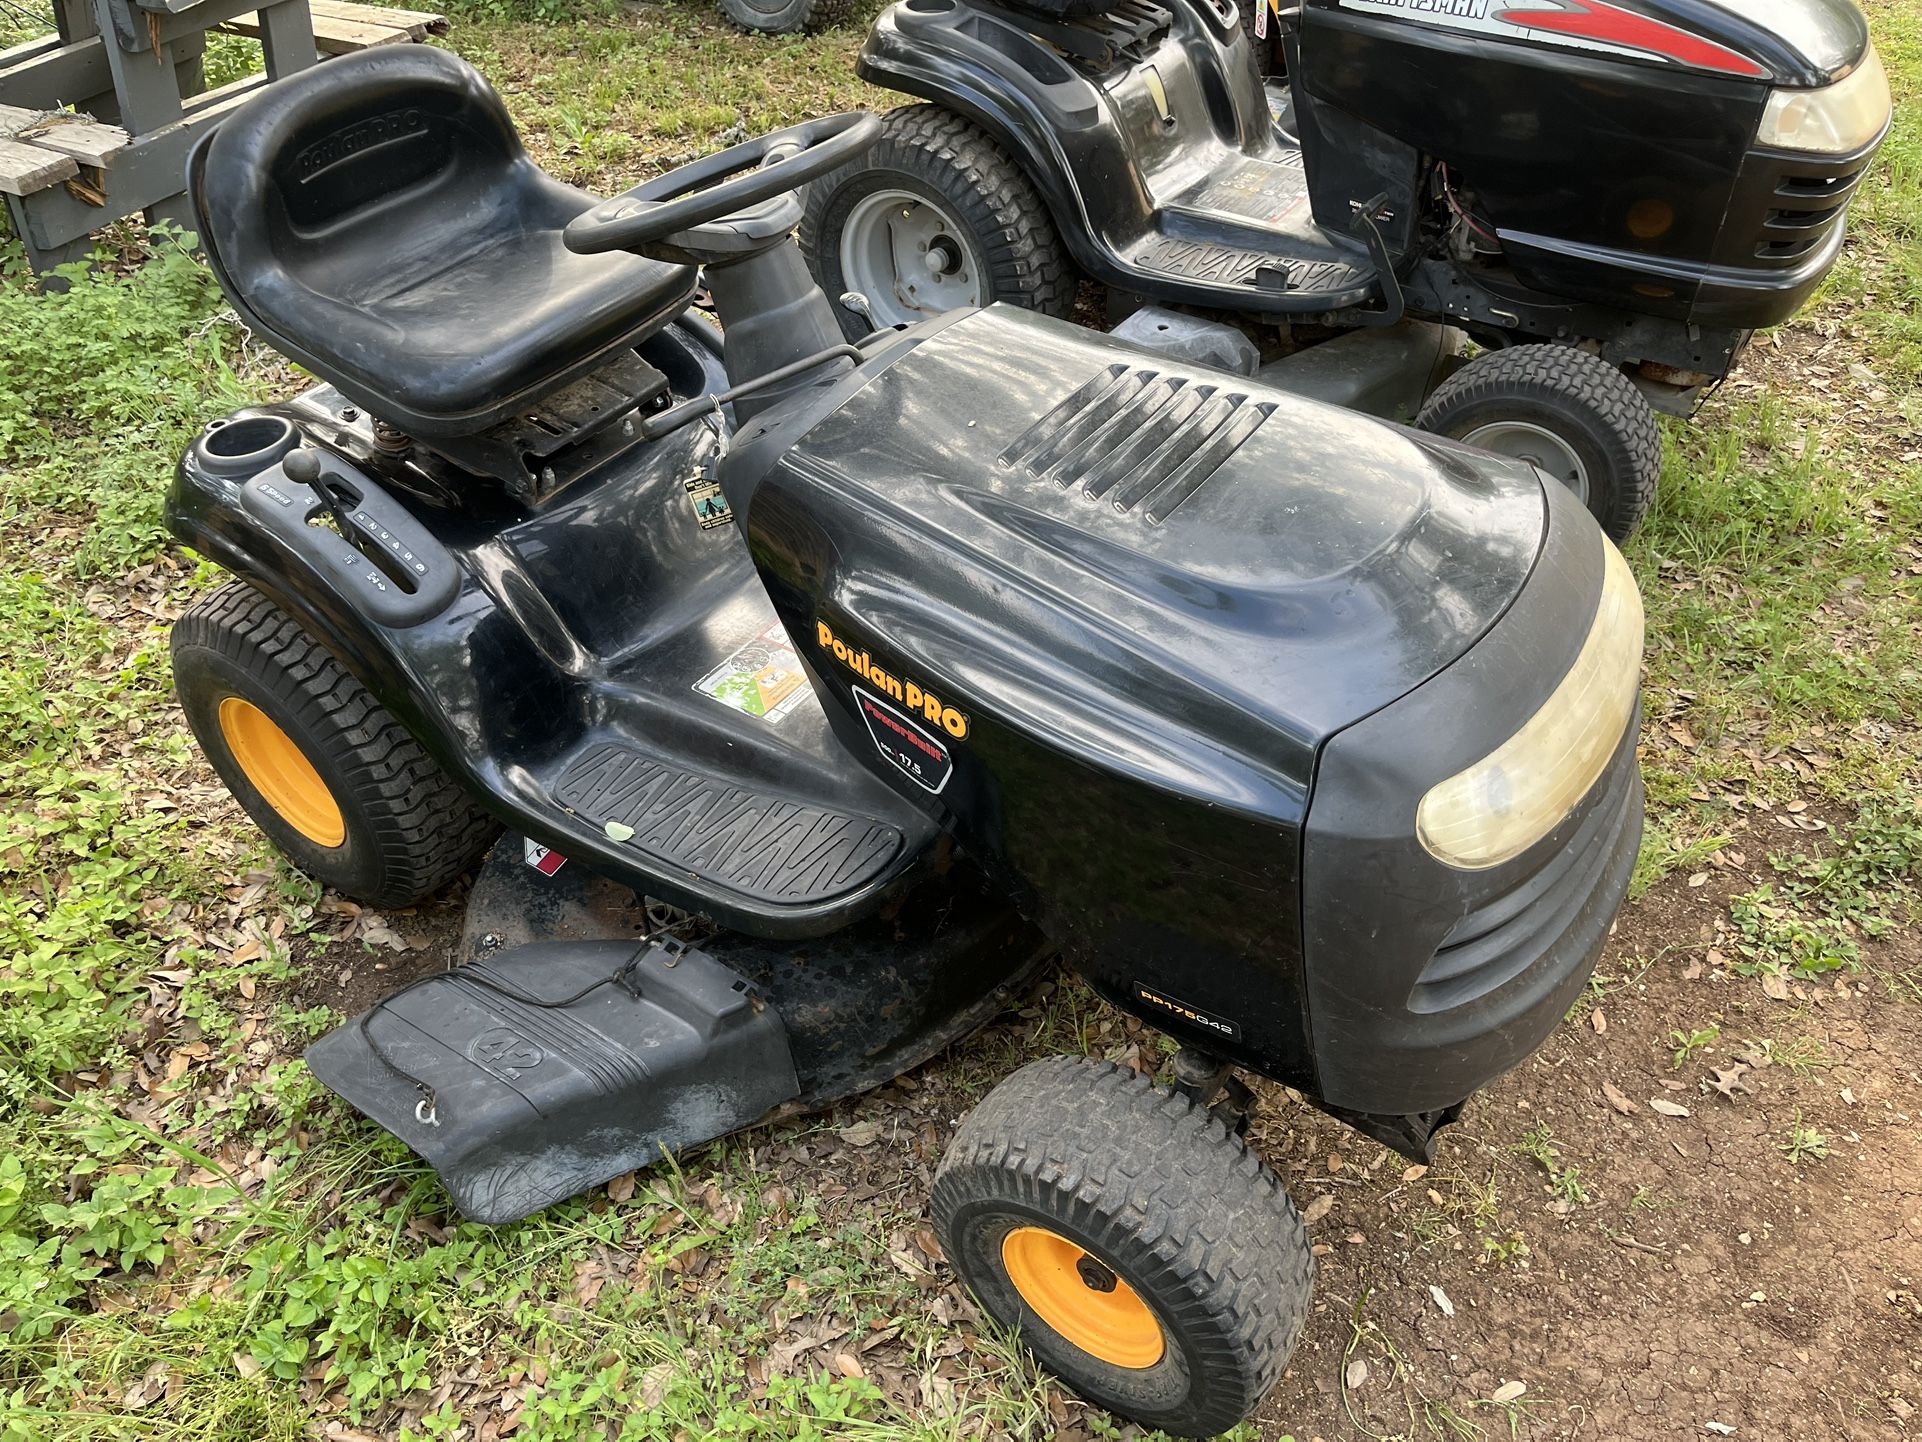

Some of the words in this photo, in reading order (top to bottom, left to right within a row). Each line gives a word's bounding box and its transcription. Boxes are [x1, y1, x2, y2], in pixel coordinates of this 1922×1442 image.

[369, 522, 378, 531] 2
[381, 532, 389, 540] 3
[392, 541, 400, 550] 4
[404, 552, 413, 561] 5
[416, 563, 425, 572] 6
[899, 753, 922, 775] 17.5
[1141, 990, 1233, 1035] PP175G42
[477, 1037, 543, 1081] 42
